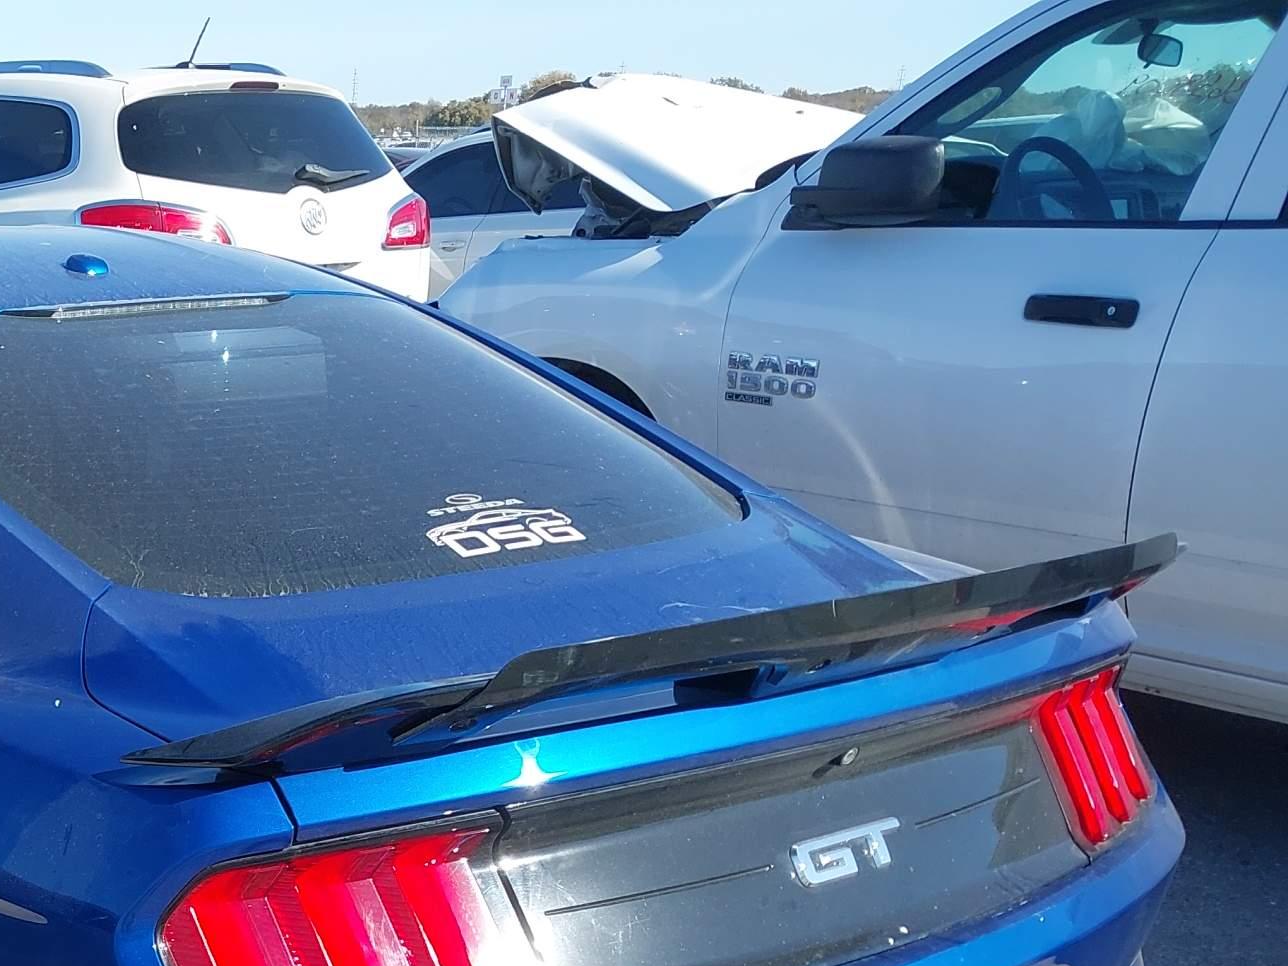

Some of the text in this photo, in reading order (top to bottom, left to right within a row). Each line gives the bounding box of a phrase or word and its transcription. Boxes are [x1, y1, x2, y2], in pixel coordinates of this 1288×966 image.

[727, 350, 821, 379] RAM
[726, 370, 817, 399] 1500
[726, 393, 771, 406] CLASSIC
[426, 498, 525, 517] STEEDA
[439, 520, 587, 558] DSG
[789, 816, 901, 888] GT
